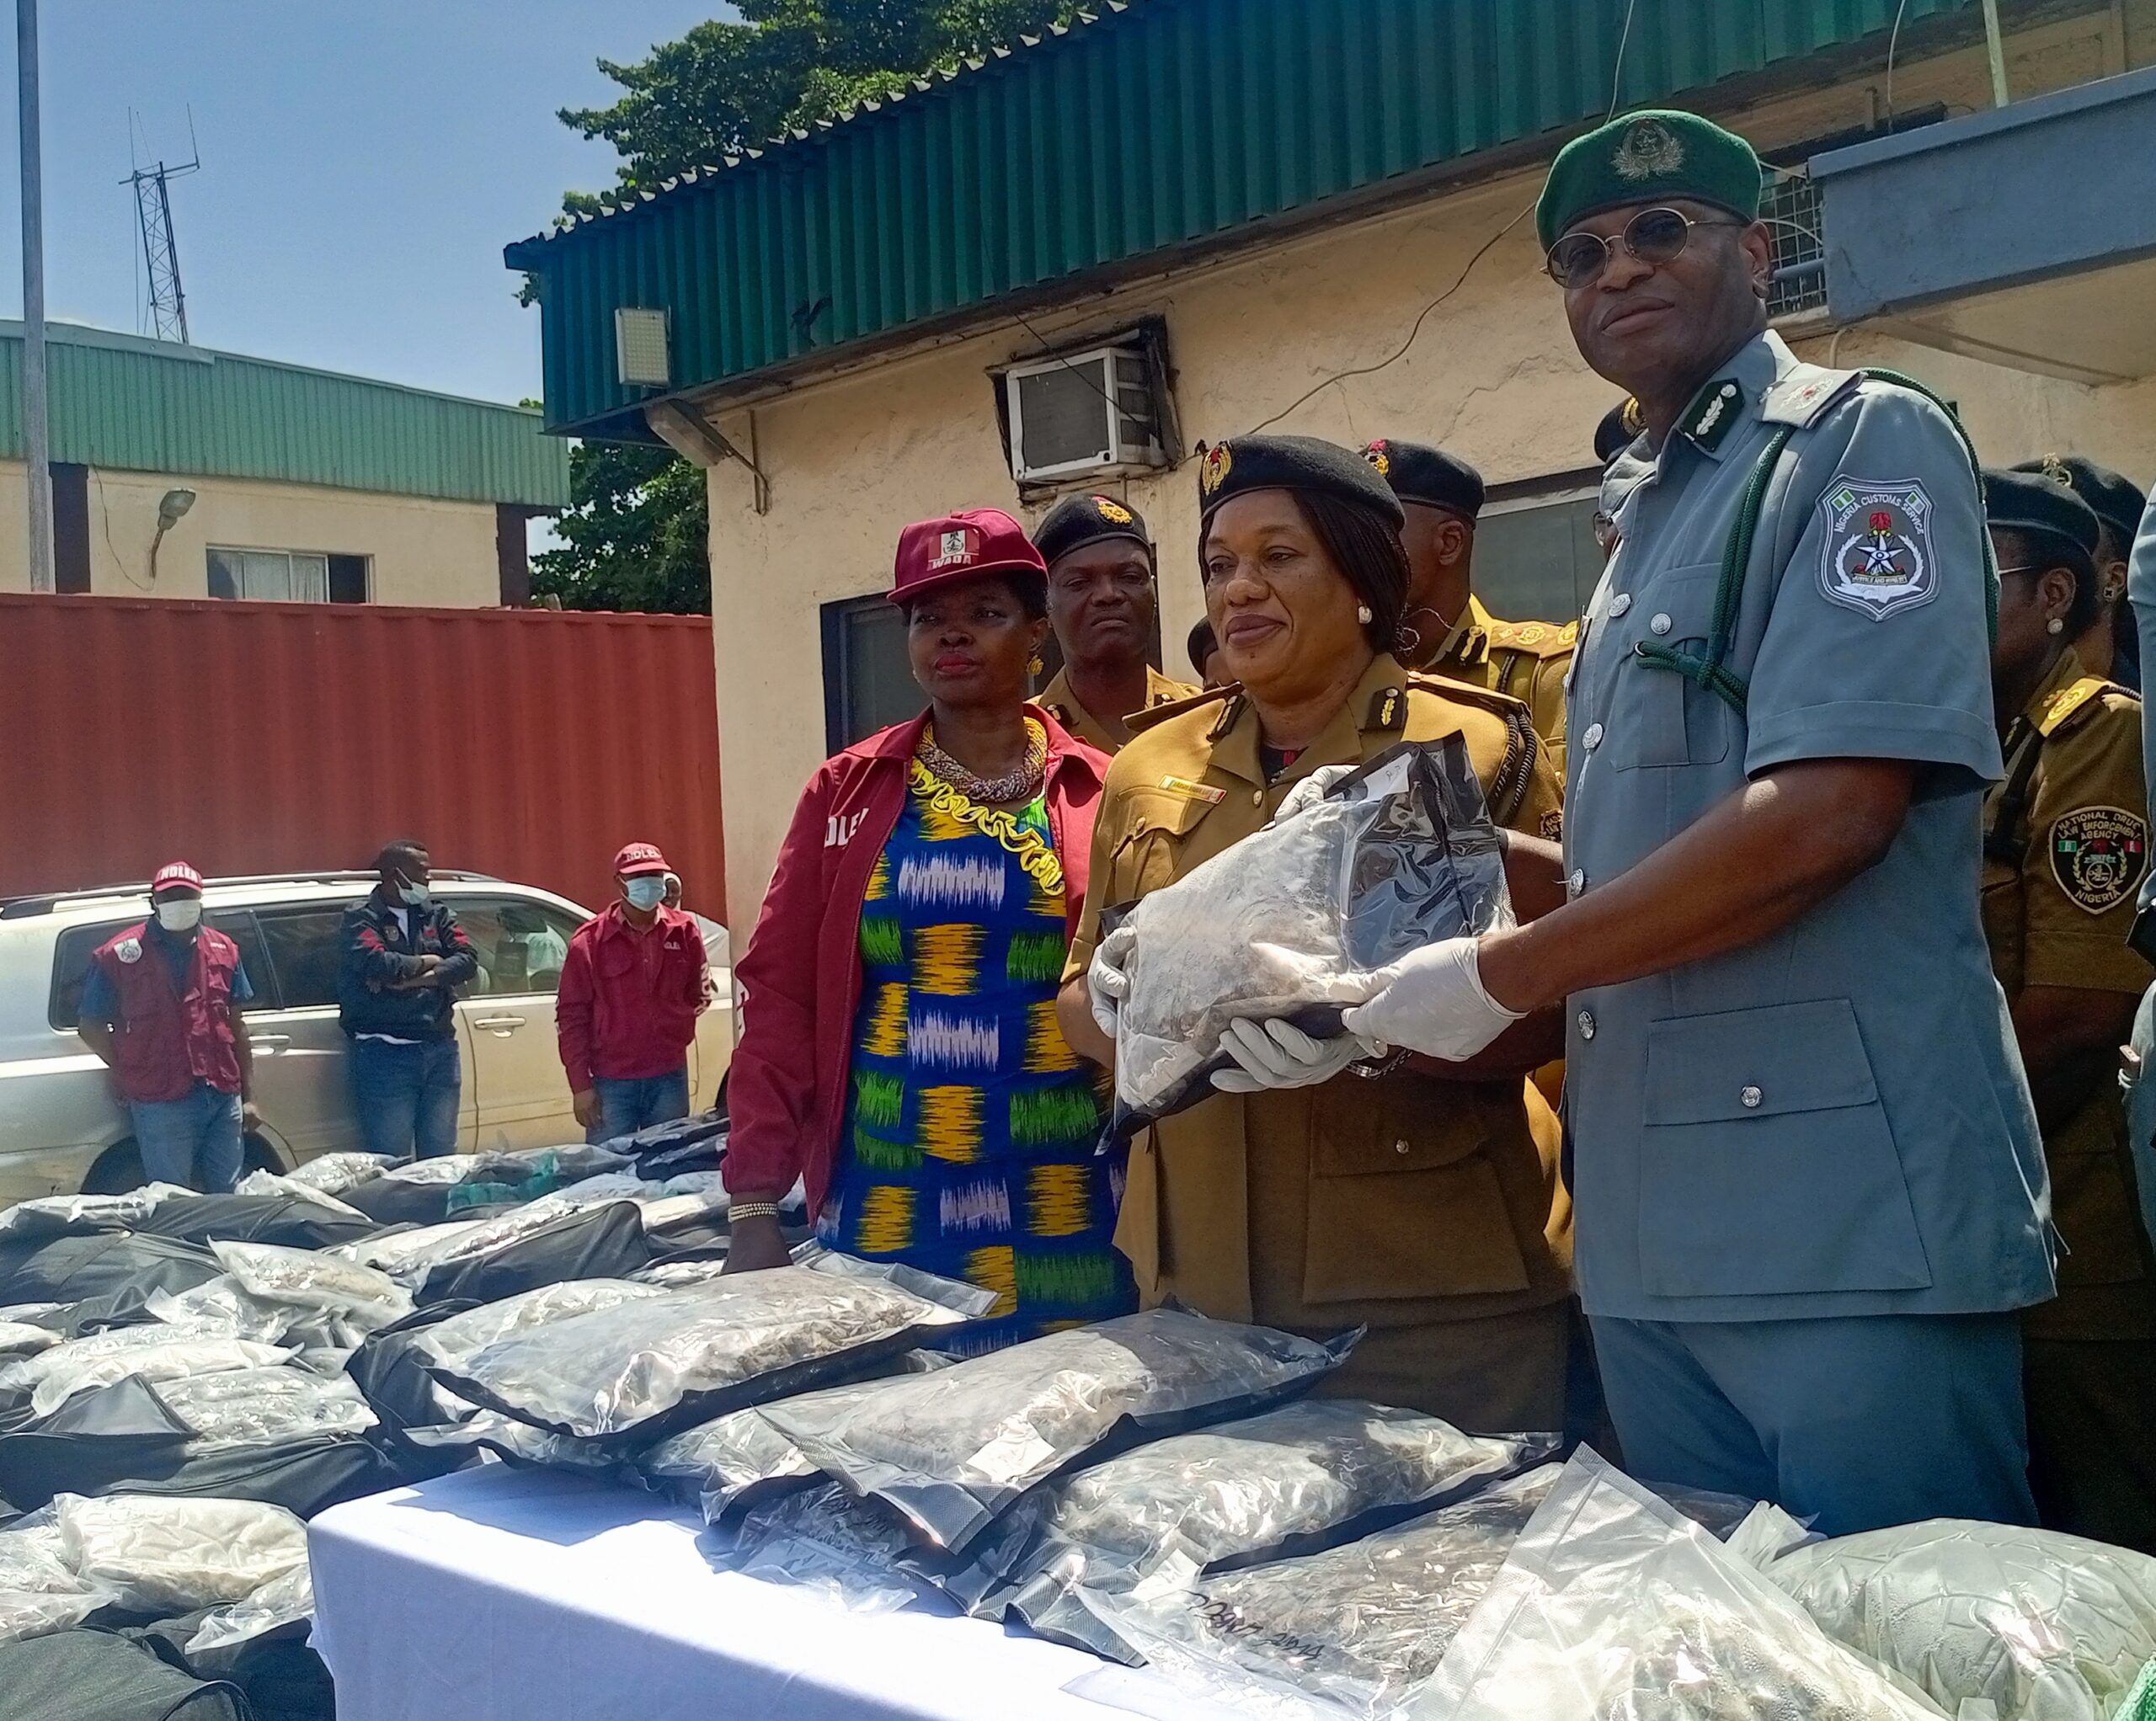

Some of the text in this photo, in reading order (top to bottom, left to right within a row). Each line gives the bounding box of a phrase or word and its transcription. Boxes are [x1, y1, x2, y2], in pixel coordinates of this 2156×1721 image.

[1834, 493, 1924, 535] NIGERIA CUSTOMS SERVICE
[932, 555, 971, 569] WADA
[2057, 811, 2141, 831] NATIONAL DRUG
[2057, 820, 2143, 840] LAW ENFORCEMENT
[2080, 829, 2120, 840] AGENCY
[2074, 889, 2121, 903] NIGERIA
